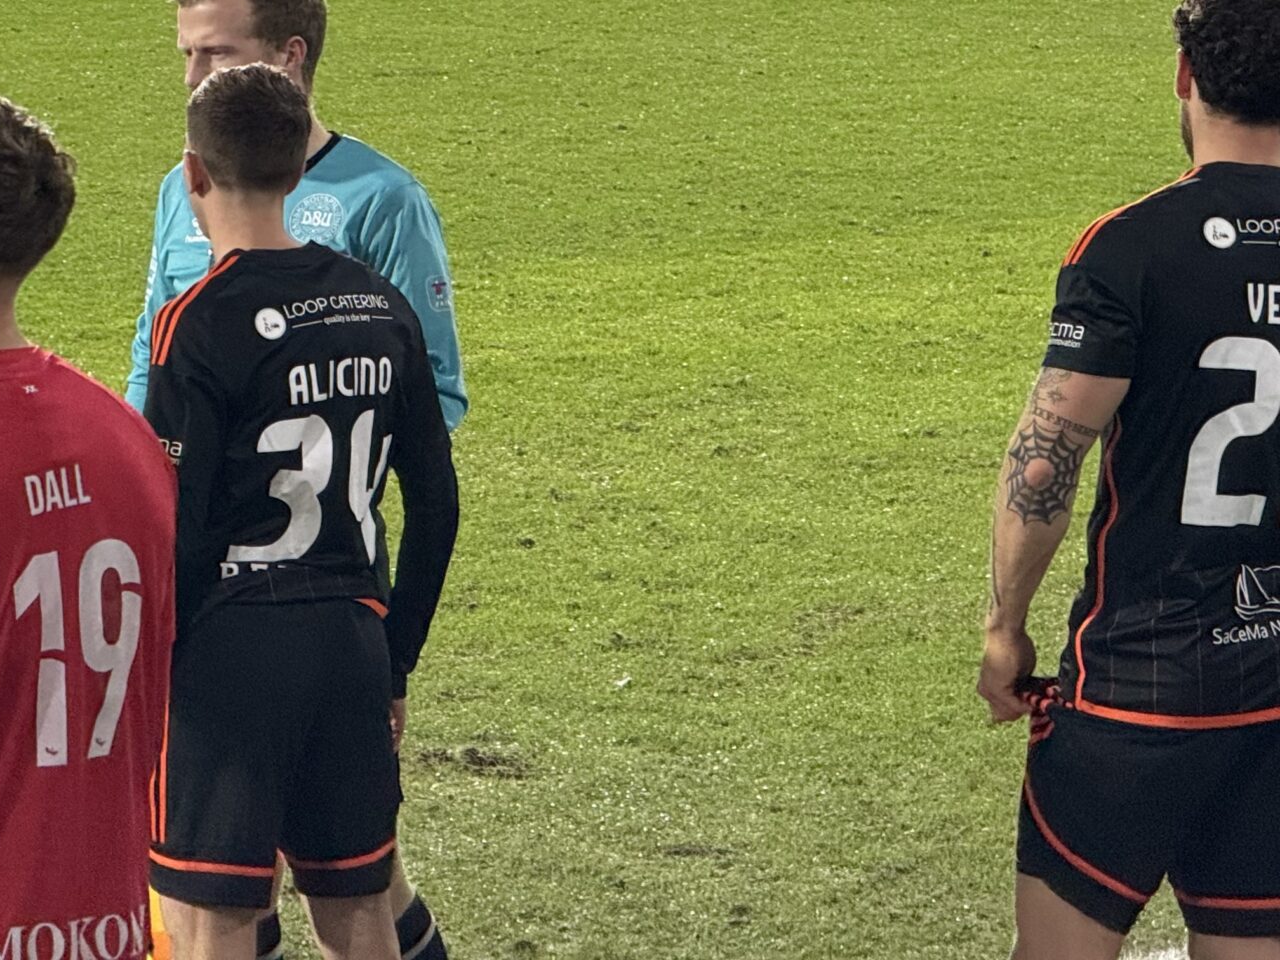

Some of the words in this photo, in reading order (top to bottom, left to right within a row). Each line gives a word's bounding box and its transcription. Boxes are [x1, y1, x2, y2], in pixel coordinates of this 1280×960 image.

[282, 297, 328, 320] LOOP
[329, 293, 390, 310] CATERING
[1180, 336, 1280, 528] 2
[24, 463, 91, 517] DALL
[225, 408, 394, 566] 34
[12, 538, 143, 769] 19
[1212, 624, 1269, 646] SaCeMa
